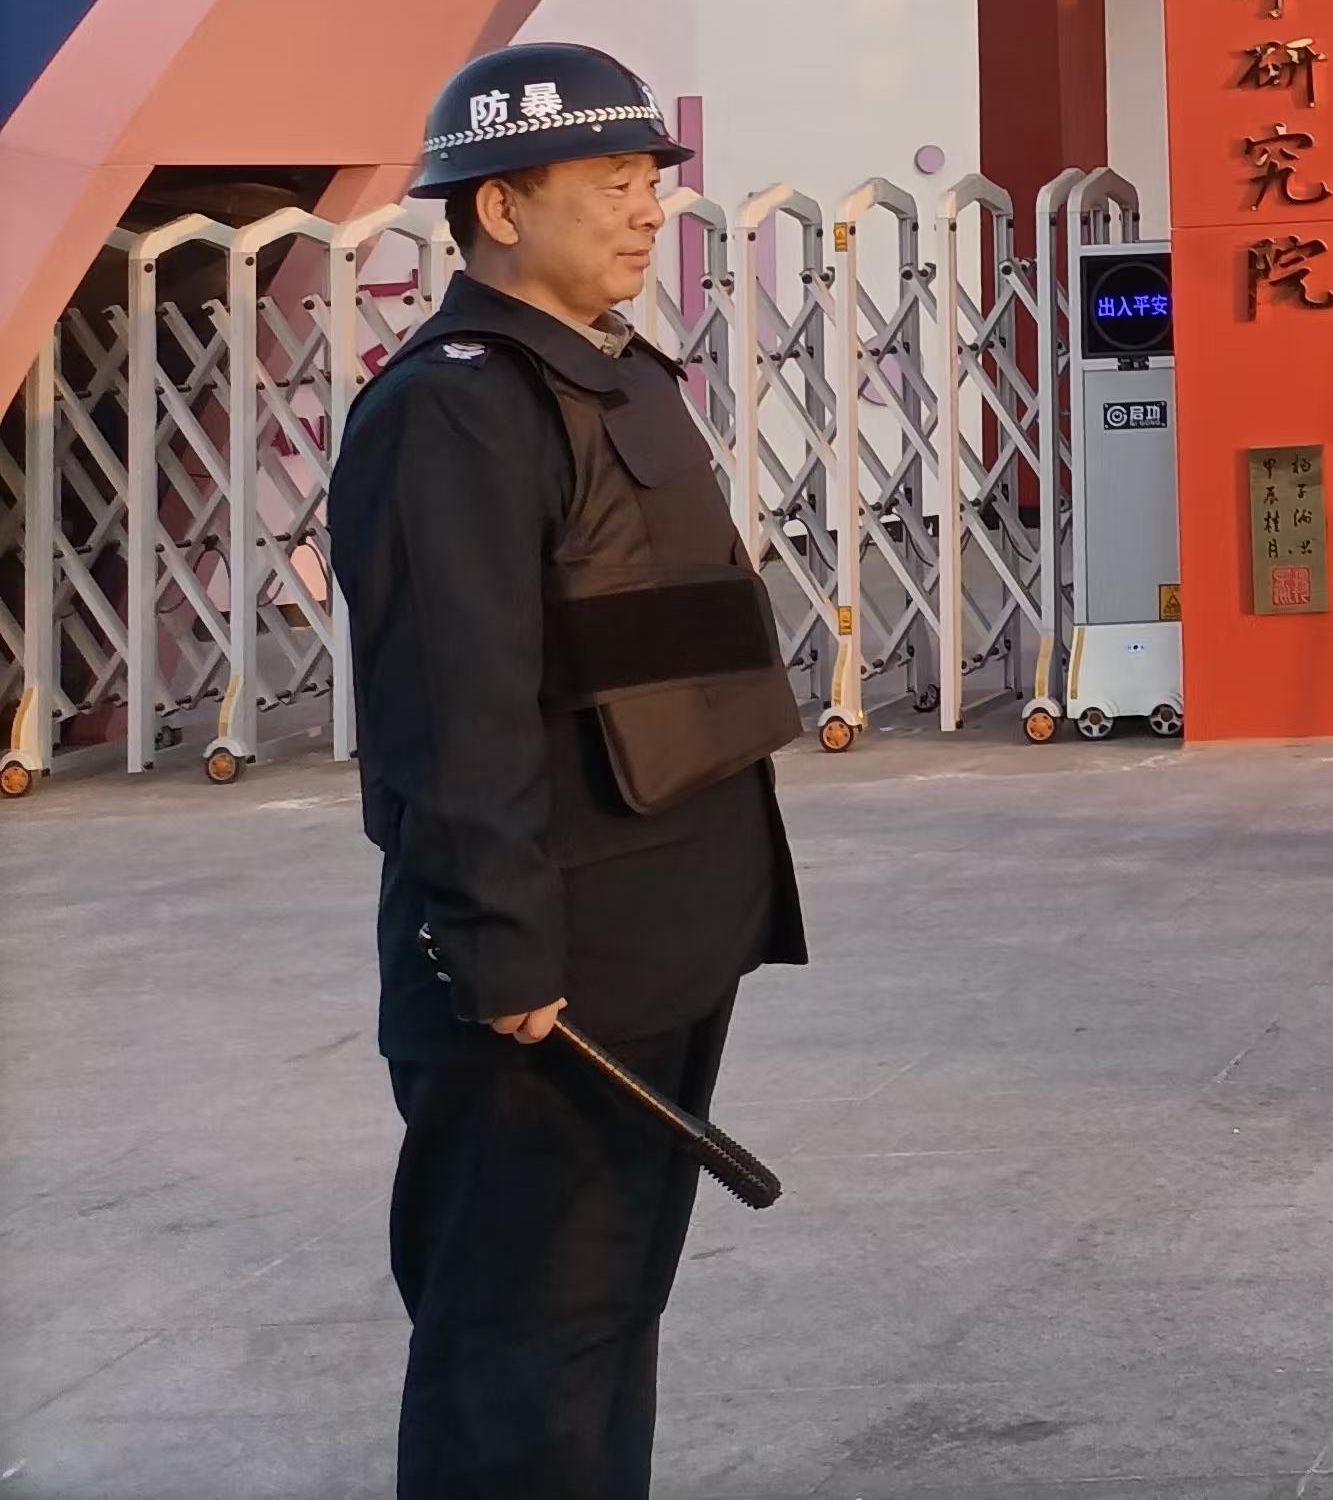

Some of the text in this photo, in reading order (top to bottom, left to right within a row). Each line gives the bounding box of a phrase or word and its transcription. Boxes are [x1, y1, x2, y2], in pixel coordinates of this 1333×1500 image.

[469, 82, 563, 130] 防暴
[1097, 294, 1168, 318] 出入平安
[1129, 404, 1161, 422] 启功
